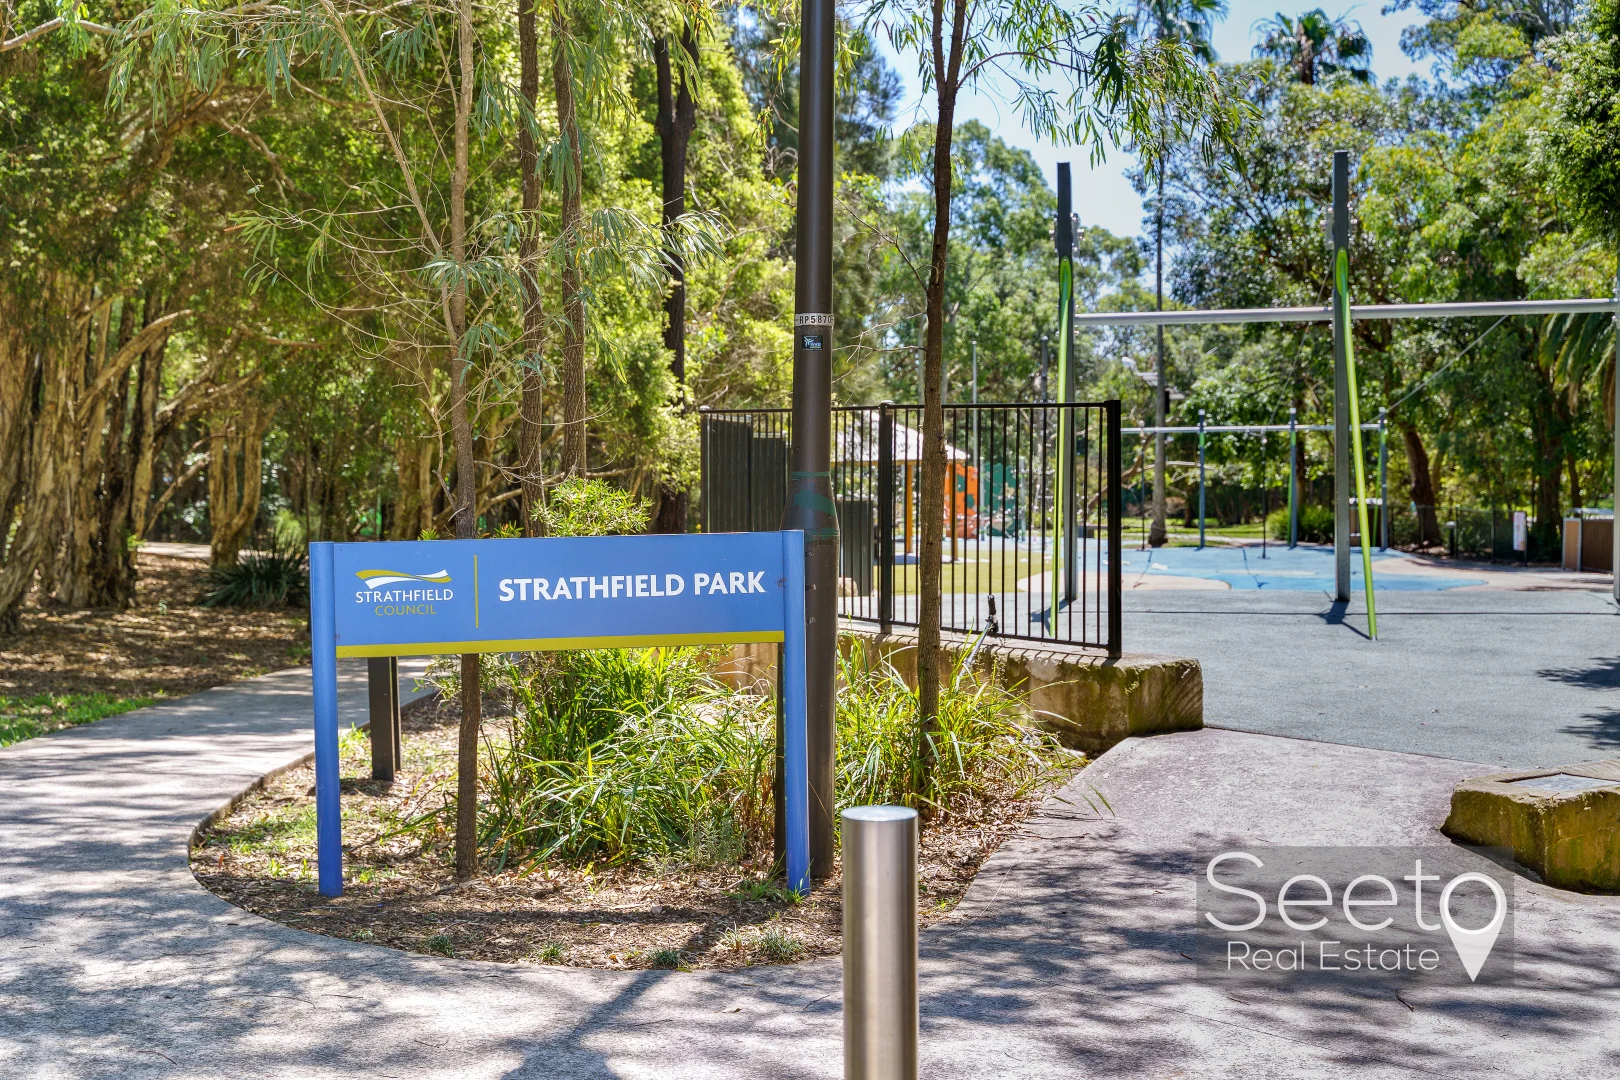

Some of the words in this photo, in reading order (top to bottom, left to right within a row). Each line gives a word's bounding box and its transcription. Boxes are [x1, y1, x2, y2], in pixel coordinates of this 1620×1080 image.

[498, 573, 685, 602] STRATHFIELD
[694, 570, 766, 595] PARK
[354, 589, 454, 604] STRATHFIELD
[374, 603, 438, 617] COUNCIL
